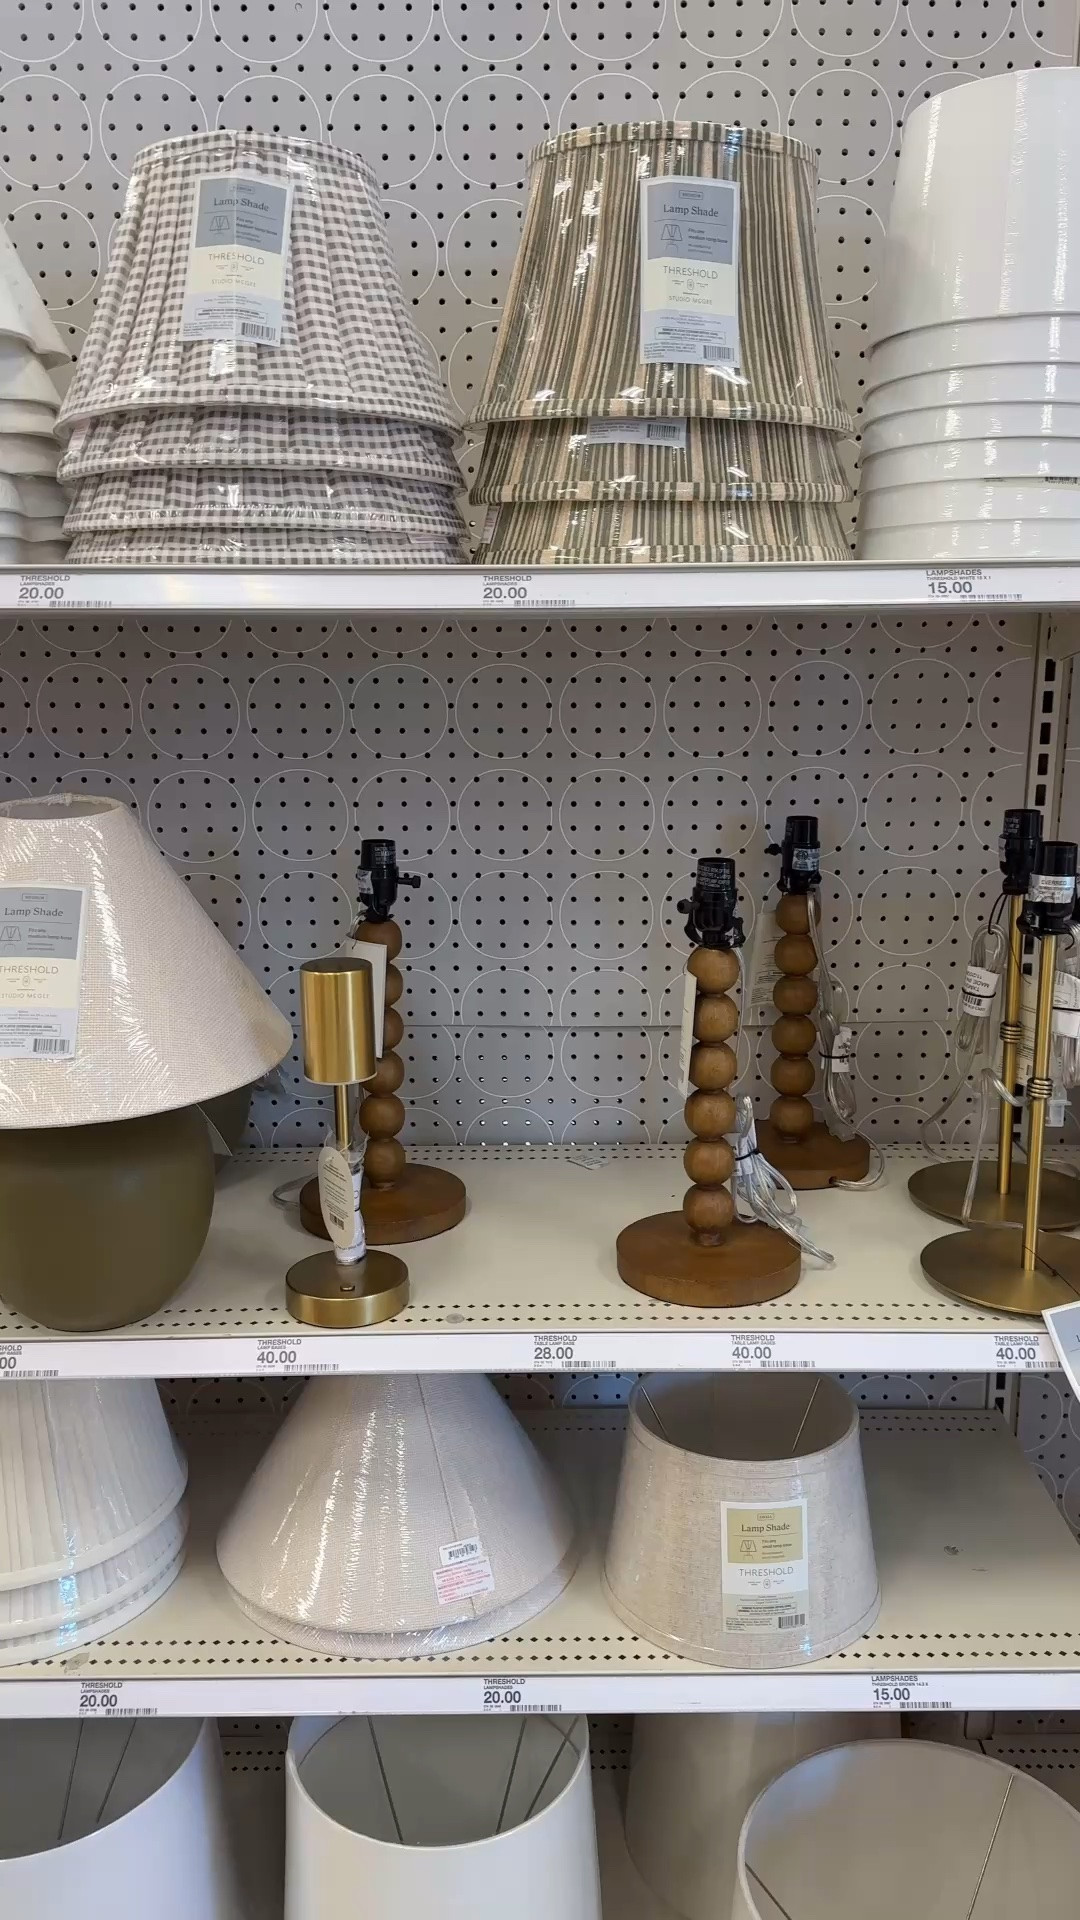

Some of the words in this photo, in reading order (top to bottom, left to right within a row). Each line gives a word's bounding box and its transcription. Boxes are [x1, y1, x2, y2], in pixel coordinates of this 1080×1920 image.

[214, 197, 238, 207] Lamp
[240, 198, 269, 212] Shade
[663, 204, 689, 216] Lamp
[691, 206, 719, 217] Shade
[208, 252, 265, 265] THRESHOLD
[663, 265, 718, 279] THRESHOLD
[19, 587, 64, 599] 20.00
[483, 587, 528, 599] 20.00
[928, 581, 973, 594] 15.00
[4, 907, 31, 916] Lamp
[33, 907, 64, 917] Shade
[257, 1338, 302, 1346] THRESHOLD
[256, 1351, 297, 1364] 40.00
[534, 1347, 574, 1360] 28.00
[732, 1346, 772, 1359] 40.00
[996, 1347, 1036, 1360] 40.00
[741, 1524, 764, 1533] Lamp
[766, 1523, 790, 1532] Shade
[739, 1566, 794, 1577] THRESHOLD
[80, 1694, 118, 1707] 20.00
[483, 1691, 522, 1704] 20.00
[873, 1688, 910, 1701] 15.00
